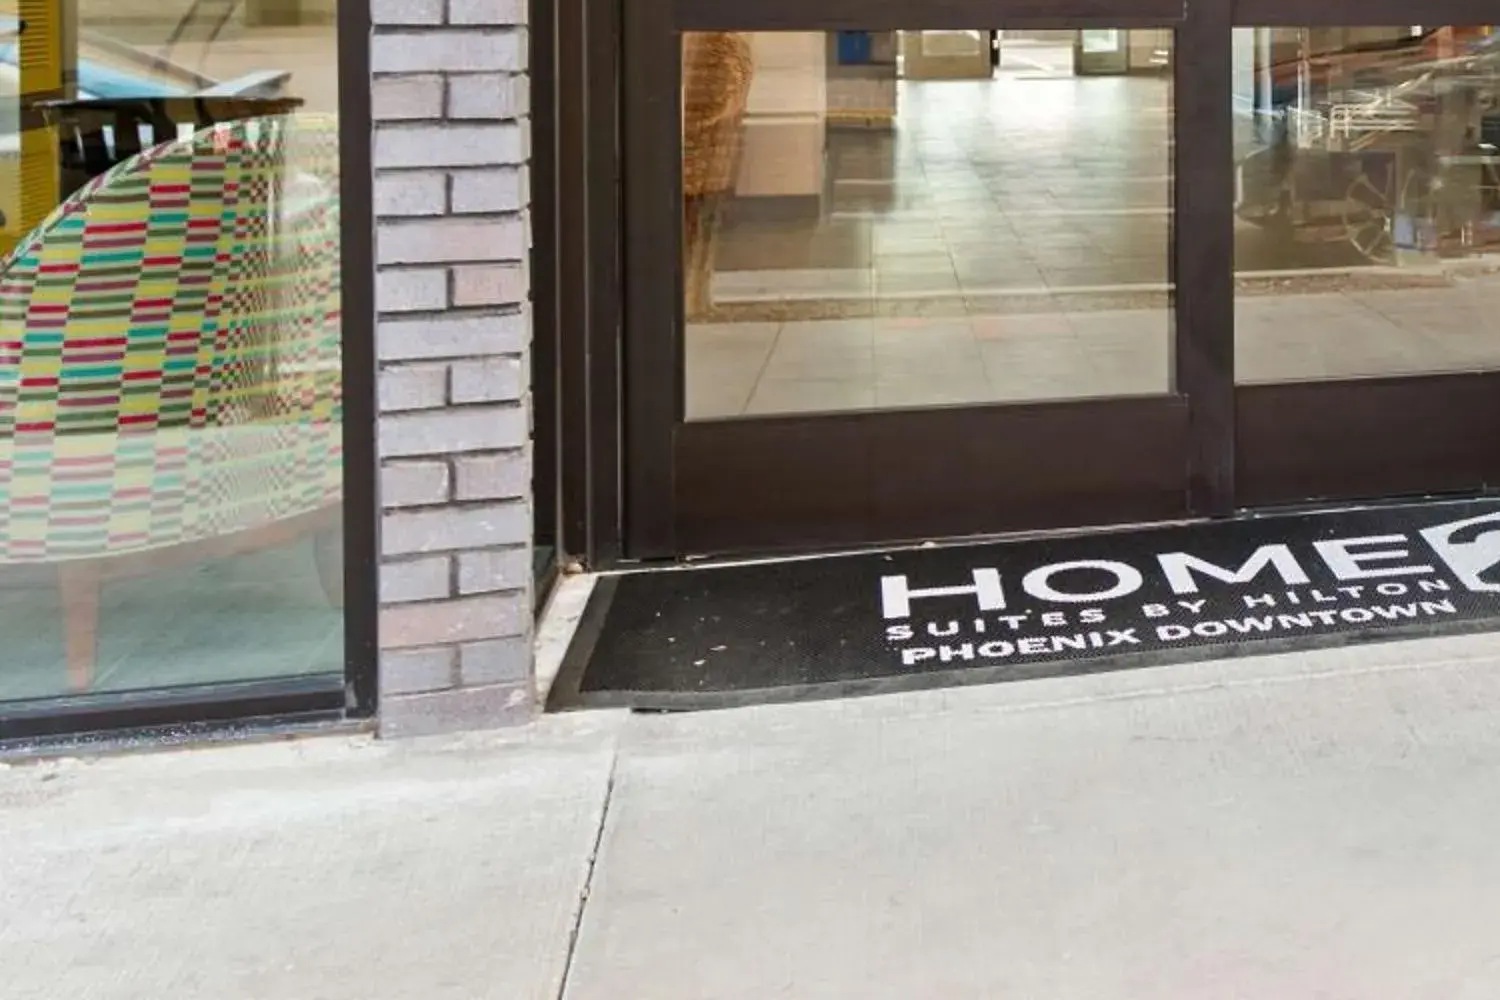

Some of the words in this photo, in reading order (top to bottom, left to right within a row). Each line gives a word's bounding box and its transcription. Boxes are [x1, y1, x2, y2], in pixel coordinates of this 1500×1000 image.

[880, 534, 1435, 619] HOME
[886, 609, 1107, 641] SUITES
[1142, 599, 1206, 619] BY
[1242, 579, 1452, 609] HILTON
[901, 628, 1141, 666] PHOENIX
[1156, 599, 1457, 641] DOWNTOWN
